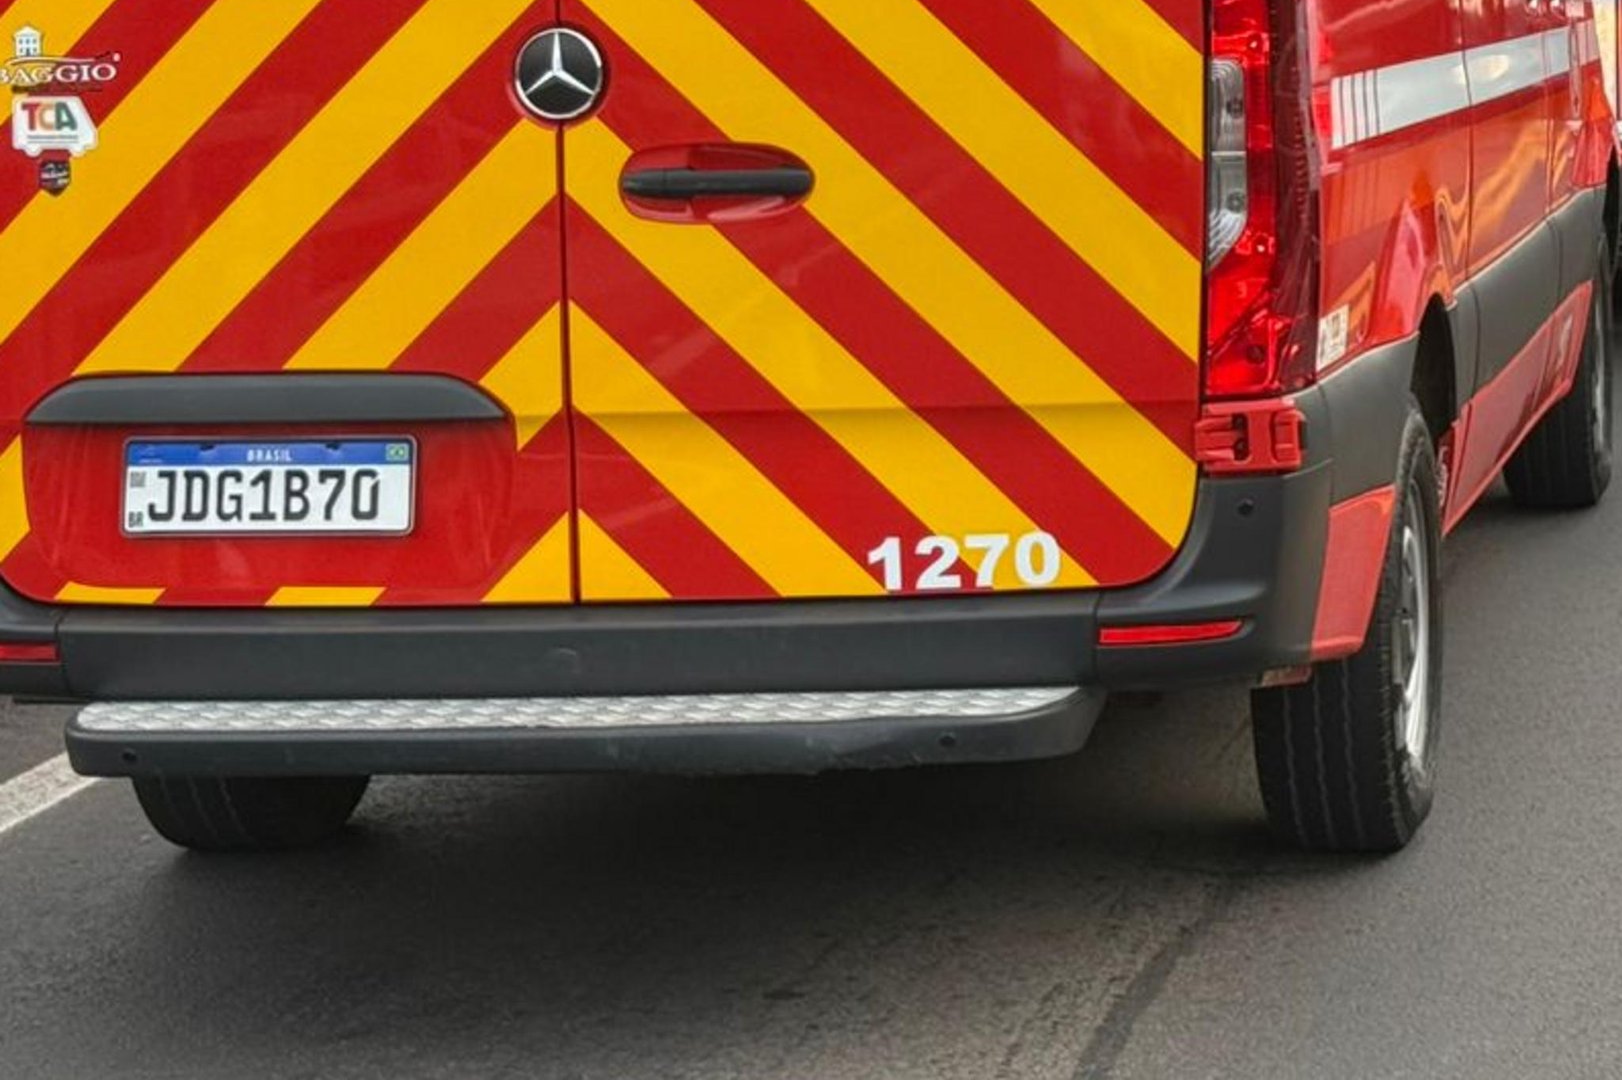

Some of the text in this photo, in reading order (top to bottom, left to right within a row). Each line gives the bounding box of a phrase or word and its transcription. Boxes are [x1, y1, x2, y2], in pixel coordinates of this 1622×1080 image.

[21, 100, 78, 132] TCA
[246, 448, 293, 463] BRASIL
[147, 468, 381, 522] JDG1B70
[867, 530, 1062, 591] 1270
